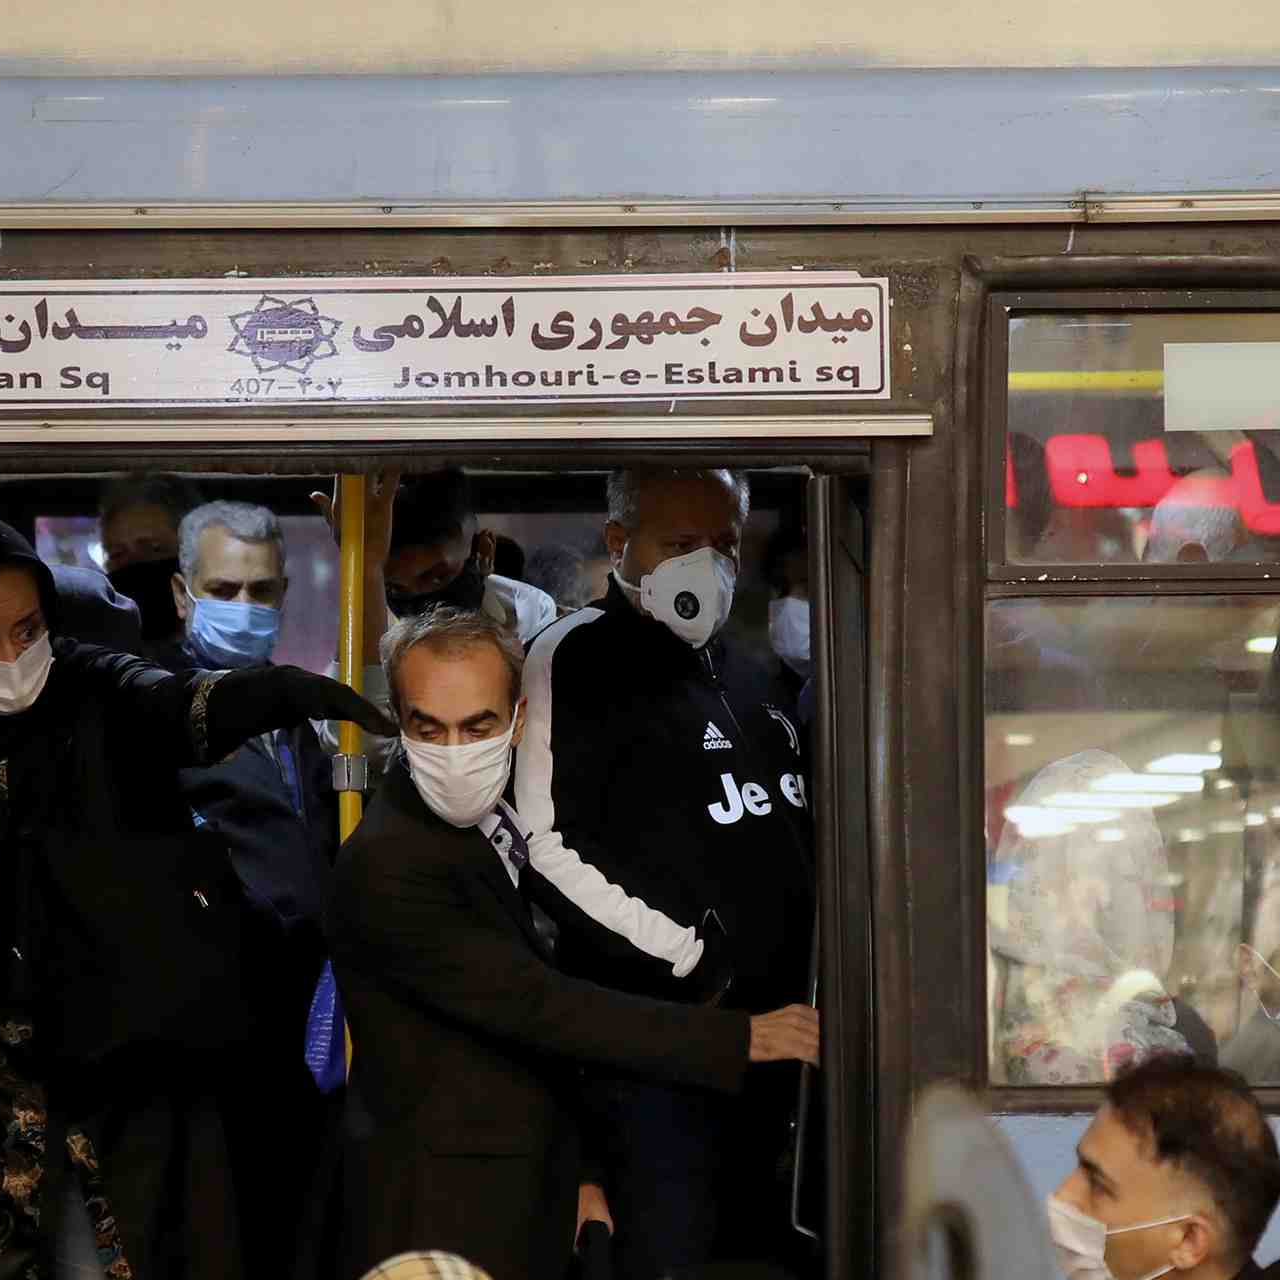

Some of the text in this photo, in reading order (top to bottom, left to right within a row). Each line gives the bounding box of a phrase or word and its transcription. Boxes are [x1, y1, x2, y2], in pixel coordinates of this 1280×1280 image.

[352, 292, 874, 351] میدان جمهوری اسلامی
[60, 366, 111, 396] Sq
[393, 360, 861, 390] Jomhouri-e-Eslami sq
